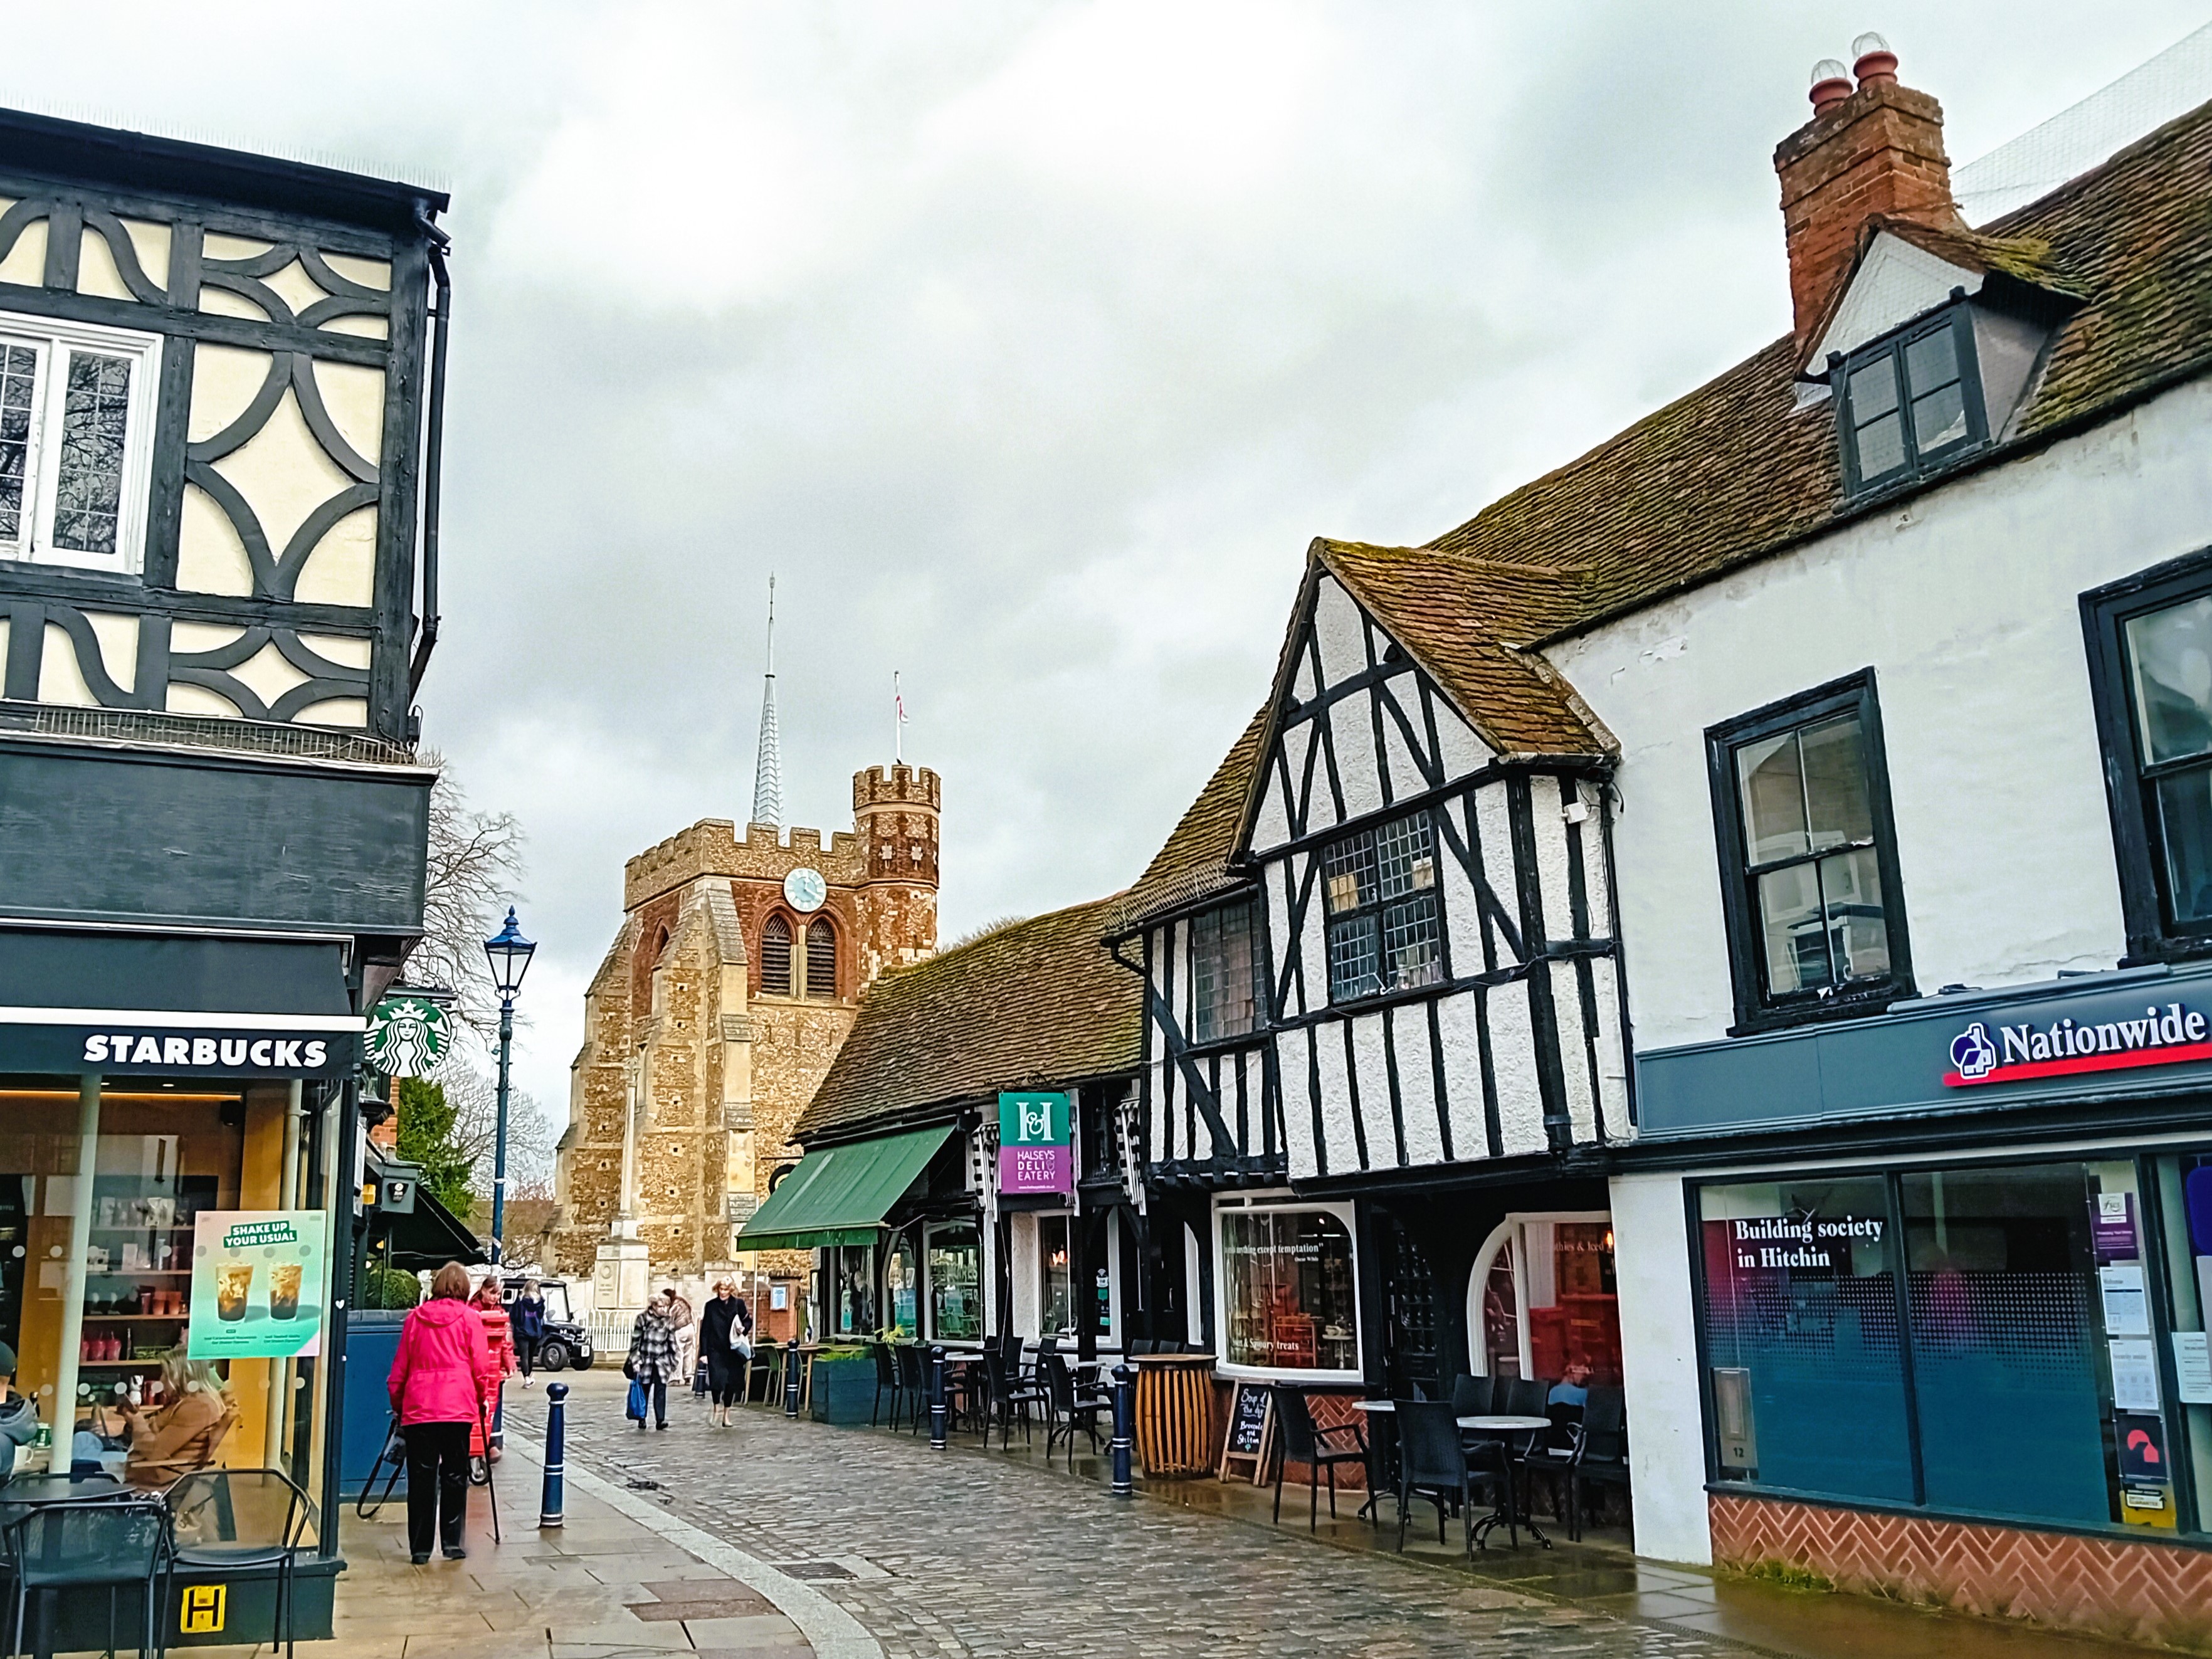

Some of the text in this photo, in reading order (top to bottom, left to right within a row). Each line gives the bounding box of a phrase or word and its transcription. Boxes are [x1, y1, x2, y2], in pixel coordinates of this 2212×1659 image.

[2000, 1003, 2206, 1063] Nationwide
[83, 1035, 327, 1067] STARBUCKS
[1018, 1150, 1055, 1161] HALSEY'S
[1018, 1161, 1045, 1171] DELI
[1018, 1171, 1055, 1181] EATERY
[233, 1223, 288, 1236] SHAKE UP
[1735, 1215, 1883, 1243] Building society
[226, 1232, 295, 1246] YOUR USUAL
[1737, 1246, 1831, 1268] in Hitchin
[1277, 1340, 1299, 1351] treats
[1733, 1447, 1744, 1458] 12
[187, 1588, 220, 1628] H
